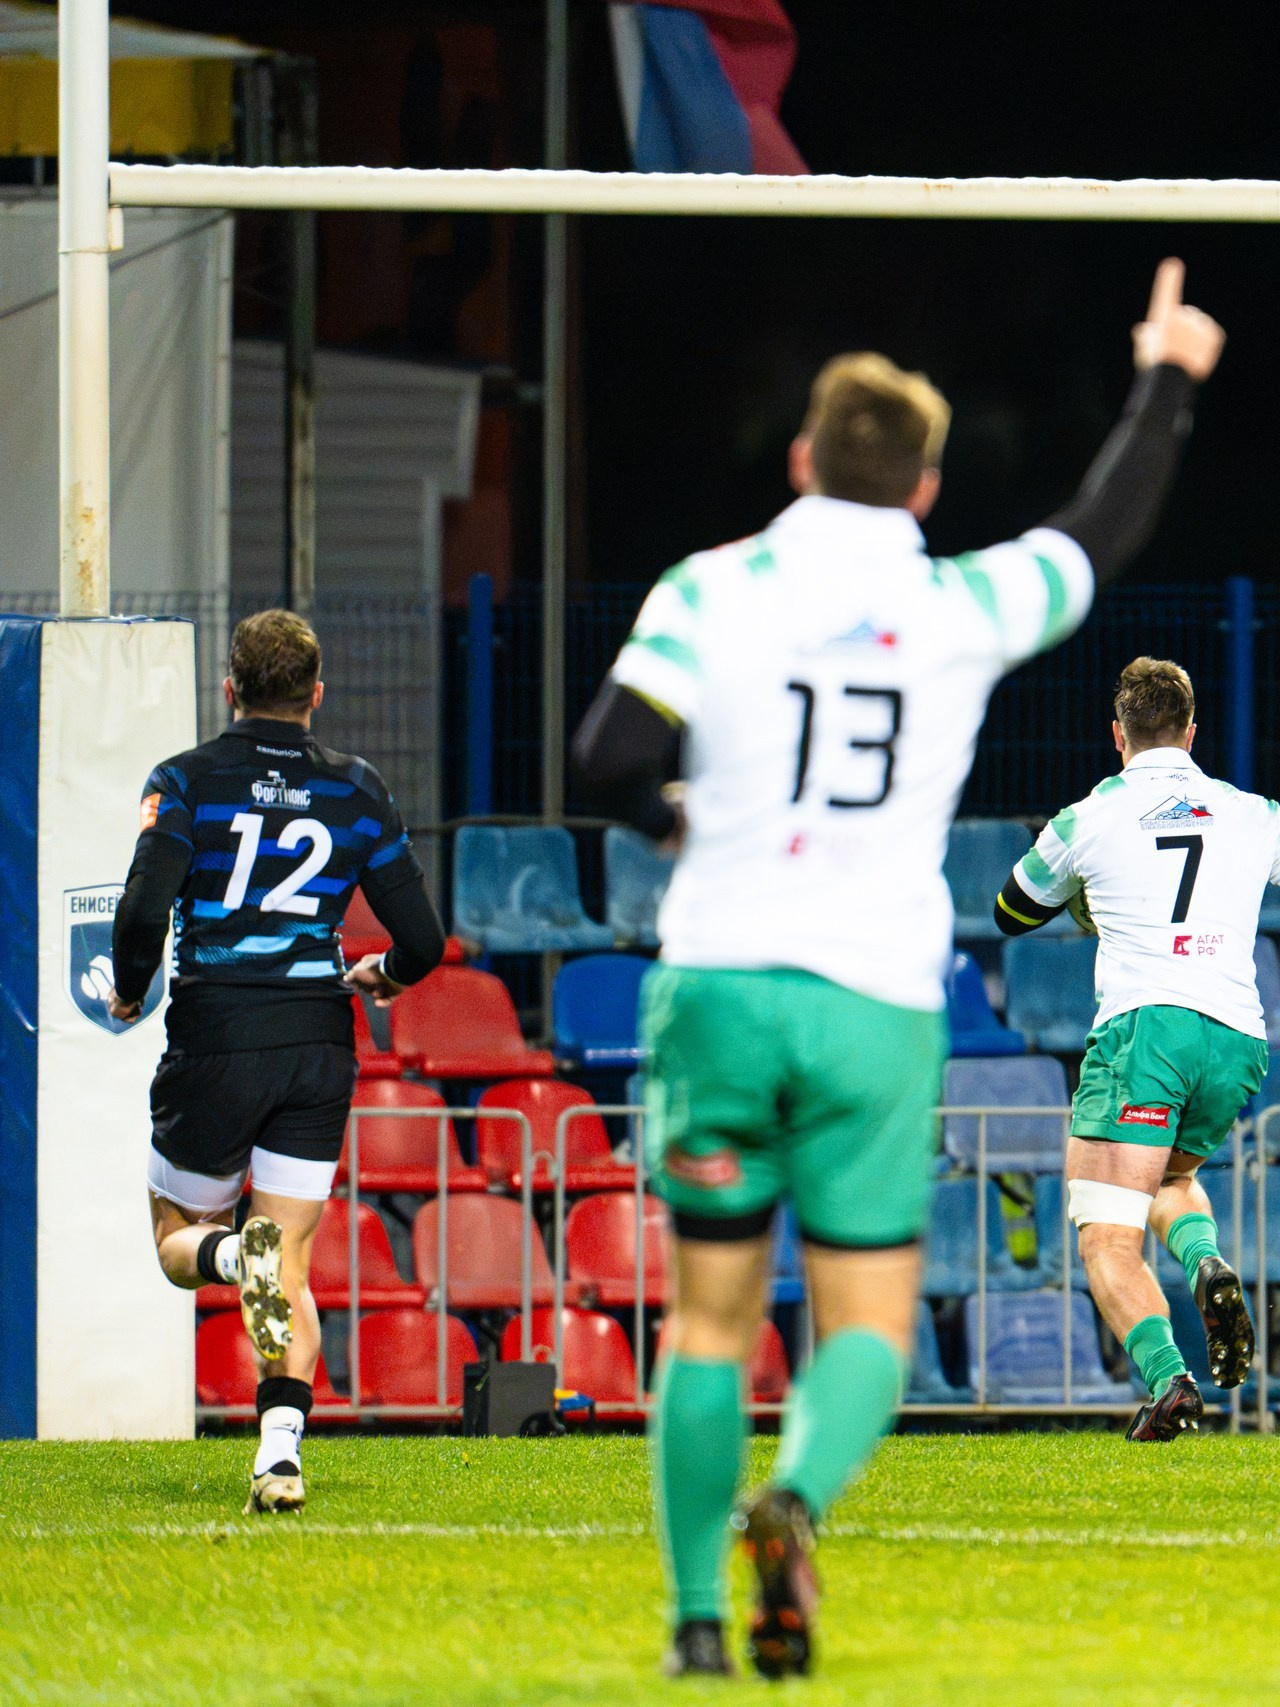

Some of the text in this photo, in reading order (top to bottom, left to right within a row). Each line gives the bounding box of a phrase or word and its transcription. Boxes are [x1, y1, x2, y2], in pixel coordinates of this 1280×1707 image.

[788, 681, 902, 808] 13
[222, 812, 333, 917] 12
[1155, 834, 1204, 924] 7
[1196, 934, 1225, 945] АГАТ
[1197, 946, 1216, 956] РФ
